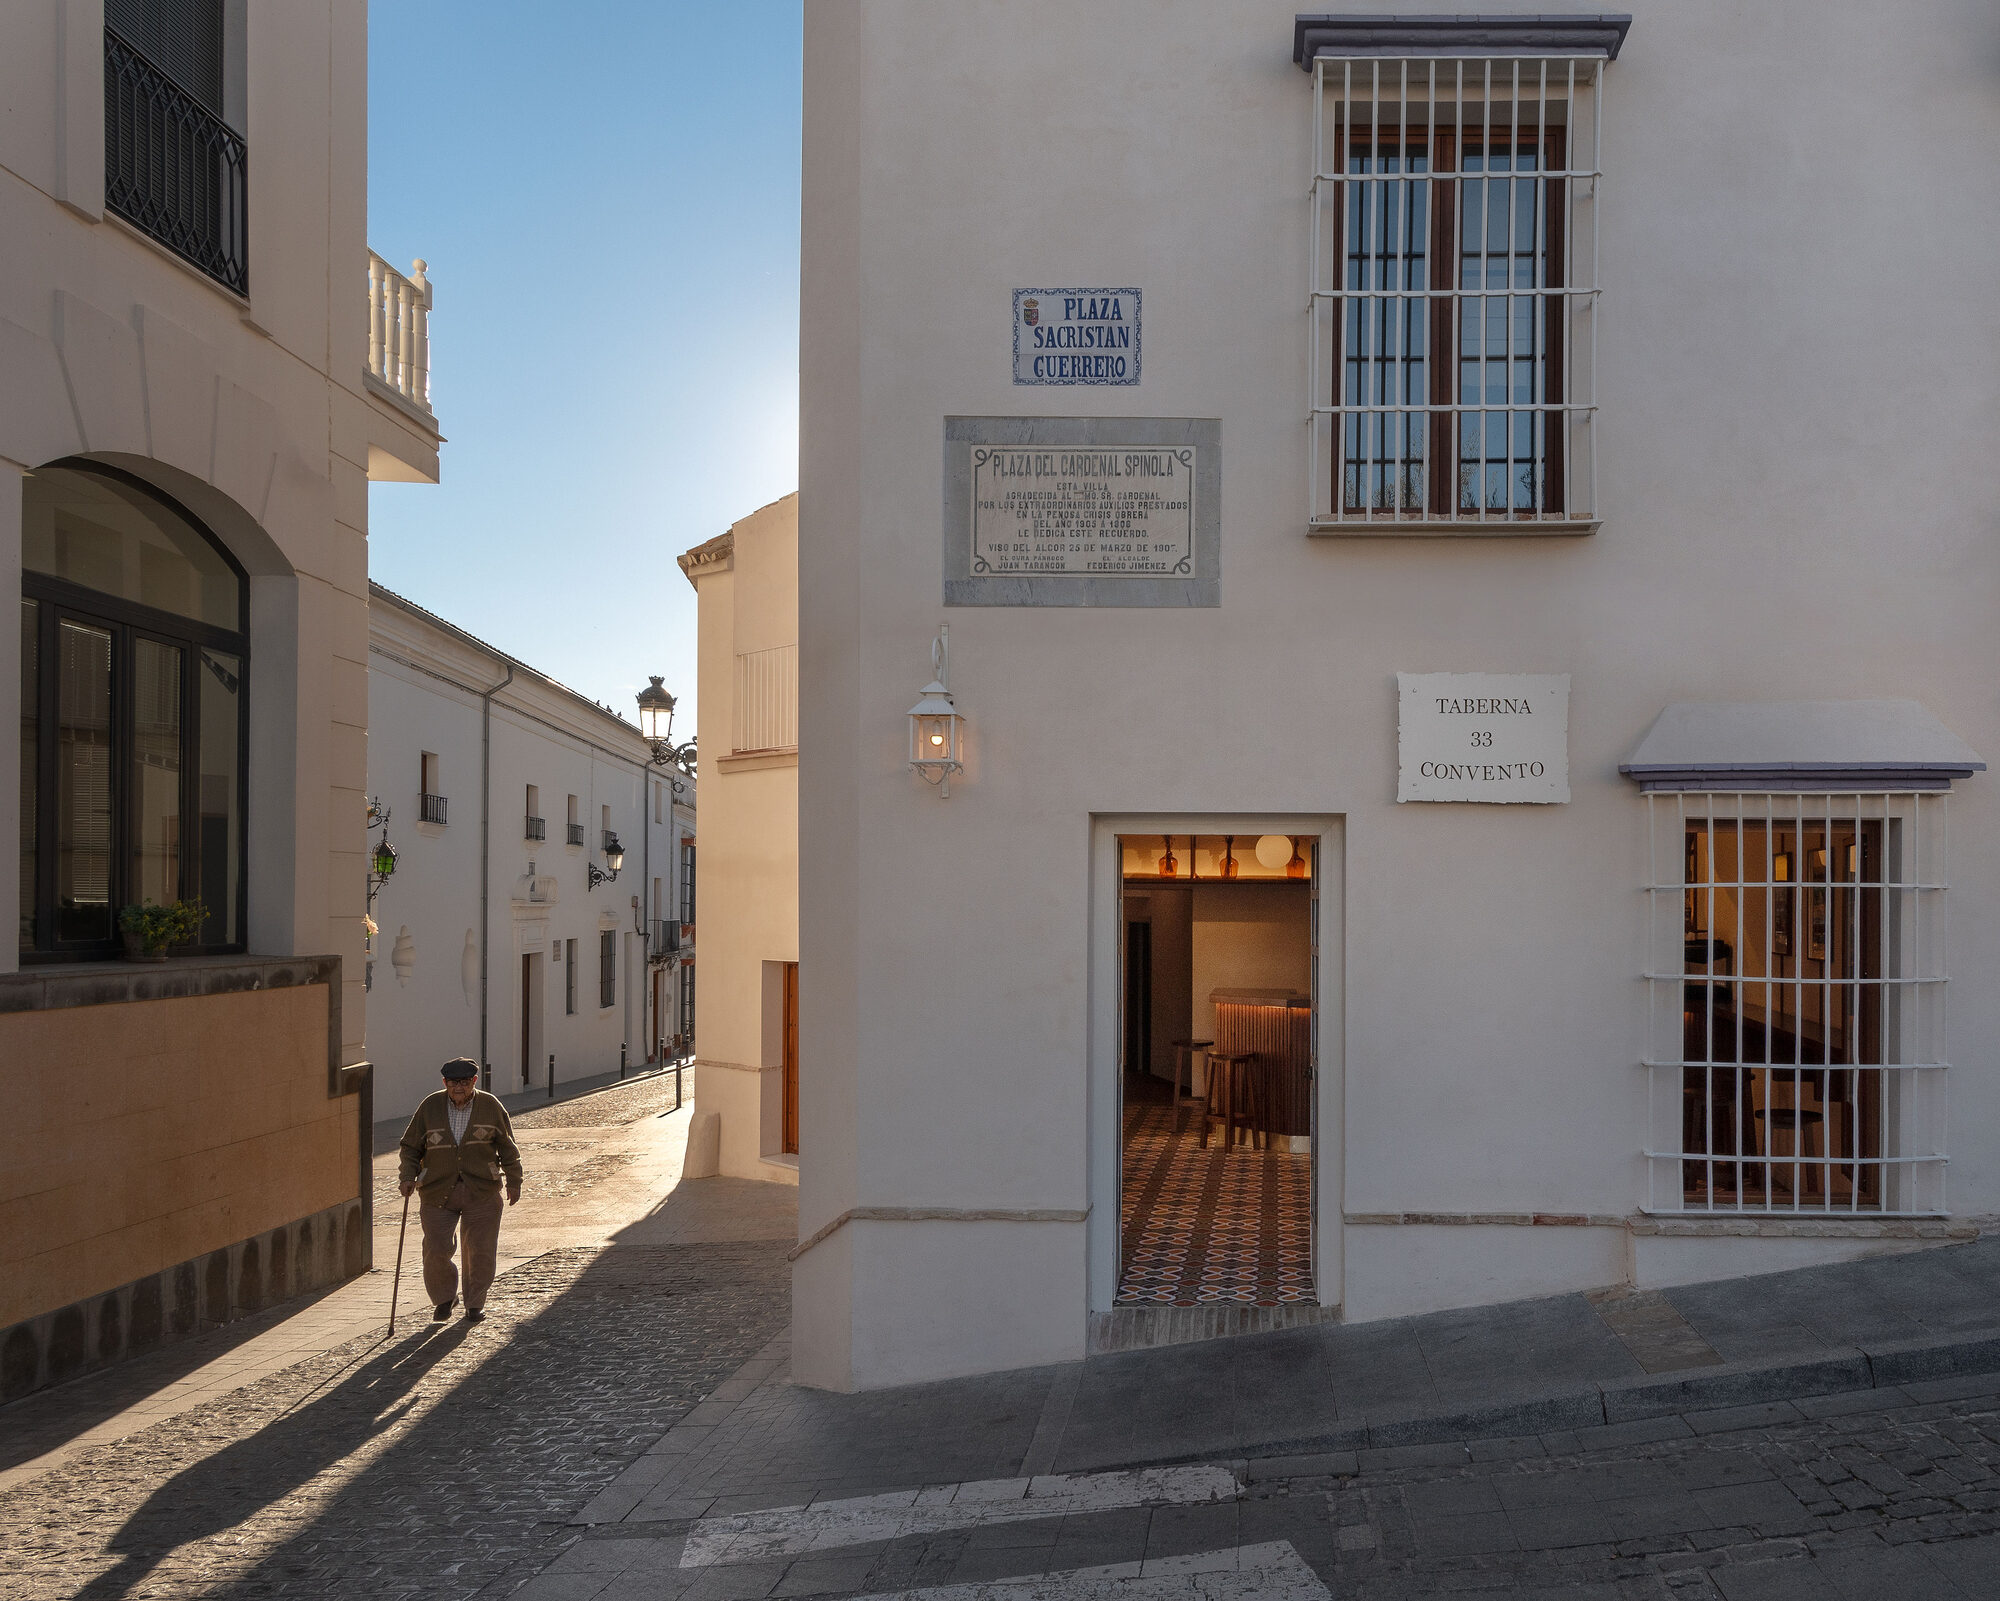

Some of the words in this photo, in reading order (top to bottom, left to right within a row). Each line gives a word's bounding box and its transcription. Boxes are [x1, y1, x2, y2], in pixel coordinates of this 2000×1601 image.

[1064, 298, 1122, 320] PLAZA
[1034, 326, 1130, 348] SACRISTAN
[1033, 355, 1126, 378] GUERRERO
[993, 455, 1031, 476] PLAZA
[1035, 455, 1057, 476] DEL
[1061, 455, 1121, 476] CARDENAL
[1125, 455, 1173, 476] SPINOLA
[1056, 482, 1077, 490] ESTA
[1083, 482, 1108, 490] VILLA
[1006, 492, 1057, 500] AGRADECIDA
[1062, 492, 1071, 500] AL
[1117, 492, 1160, 500] CARDENAL
[978, 501, 994, 509] POR
[999, 501, 1014, 509] LOS
[1019, 501, 1096, 509] EXTRAORDINARIOS
[1100, 501, 1134, 509] AUXILIOS
[1138, 501, 1187, 509] PRESTADOS
[1017, 511, 1027, 519] EN
[1032, 511, 1042, 519] LA
[1047, 511, 1080, 519] PENOSA
[1084, 511, 1111, 519] CRISIS
[1115, 511, 1148, 519] OBRERA
[1034, 520, 1051, 528] DEL
[1075, 520, 1096, 528] 1905
[1018, 529, 1029, 538] LE
[1034, 529, 1065, 538] DEDICA
[1070, 529, 1092, 538] ESTE
[1099, 529, 1149, 538] RECUERDO.
[989, 544, 1009, 552] VISO
[1013, 544, 1030, 552] DEL
[1036, 544, 1065, 552] ALCOR
[1084, 544, 1095, 552] DE
[1100, 544, 1132, 552] MARZO
[1137, 544, 1148, 552] DE
[1087, 562, 1126, 570] FEDERICO
[1129, 562, 1166, 570] JIMENEZ
[1436, 699, 1532, 714] TABERNA
[1470, 731, 1493, 747] 33
[1420, 761, 1545, 781] CONVENTO
